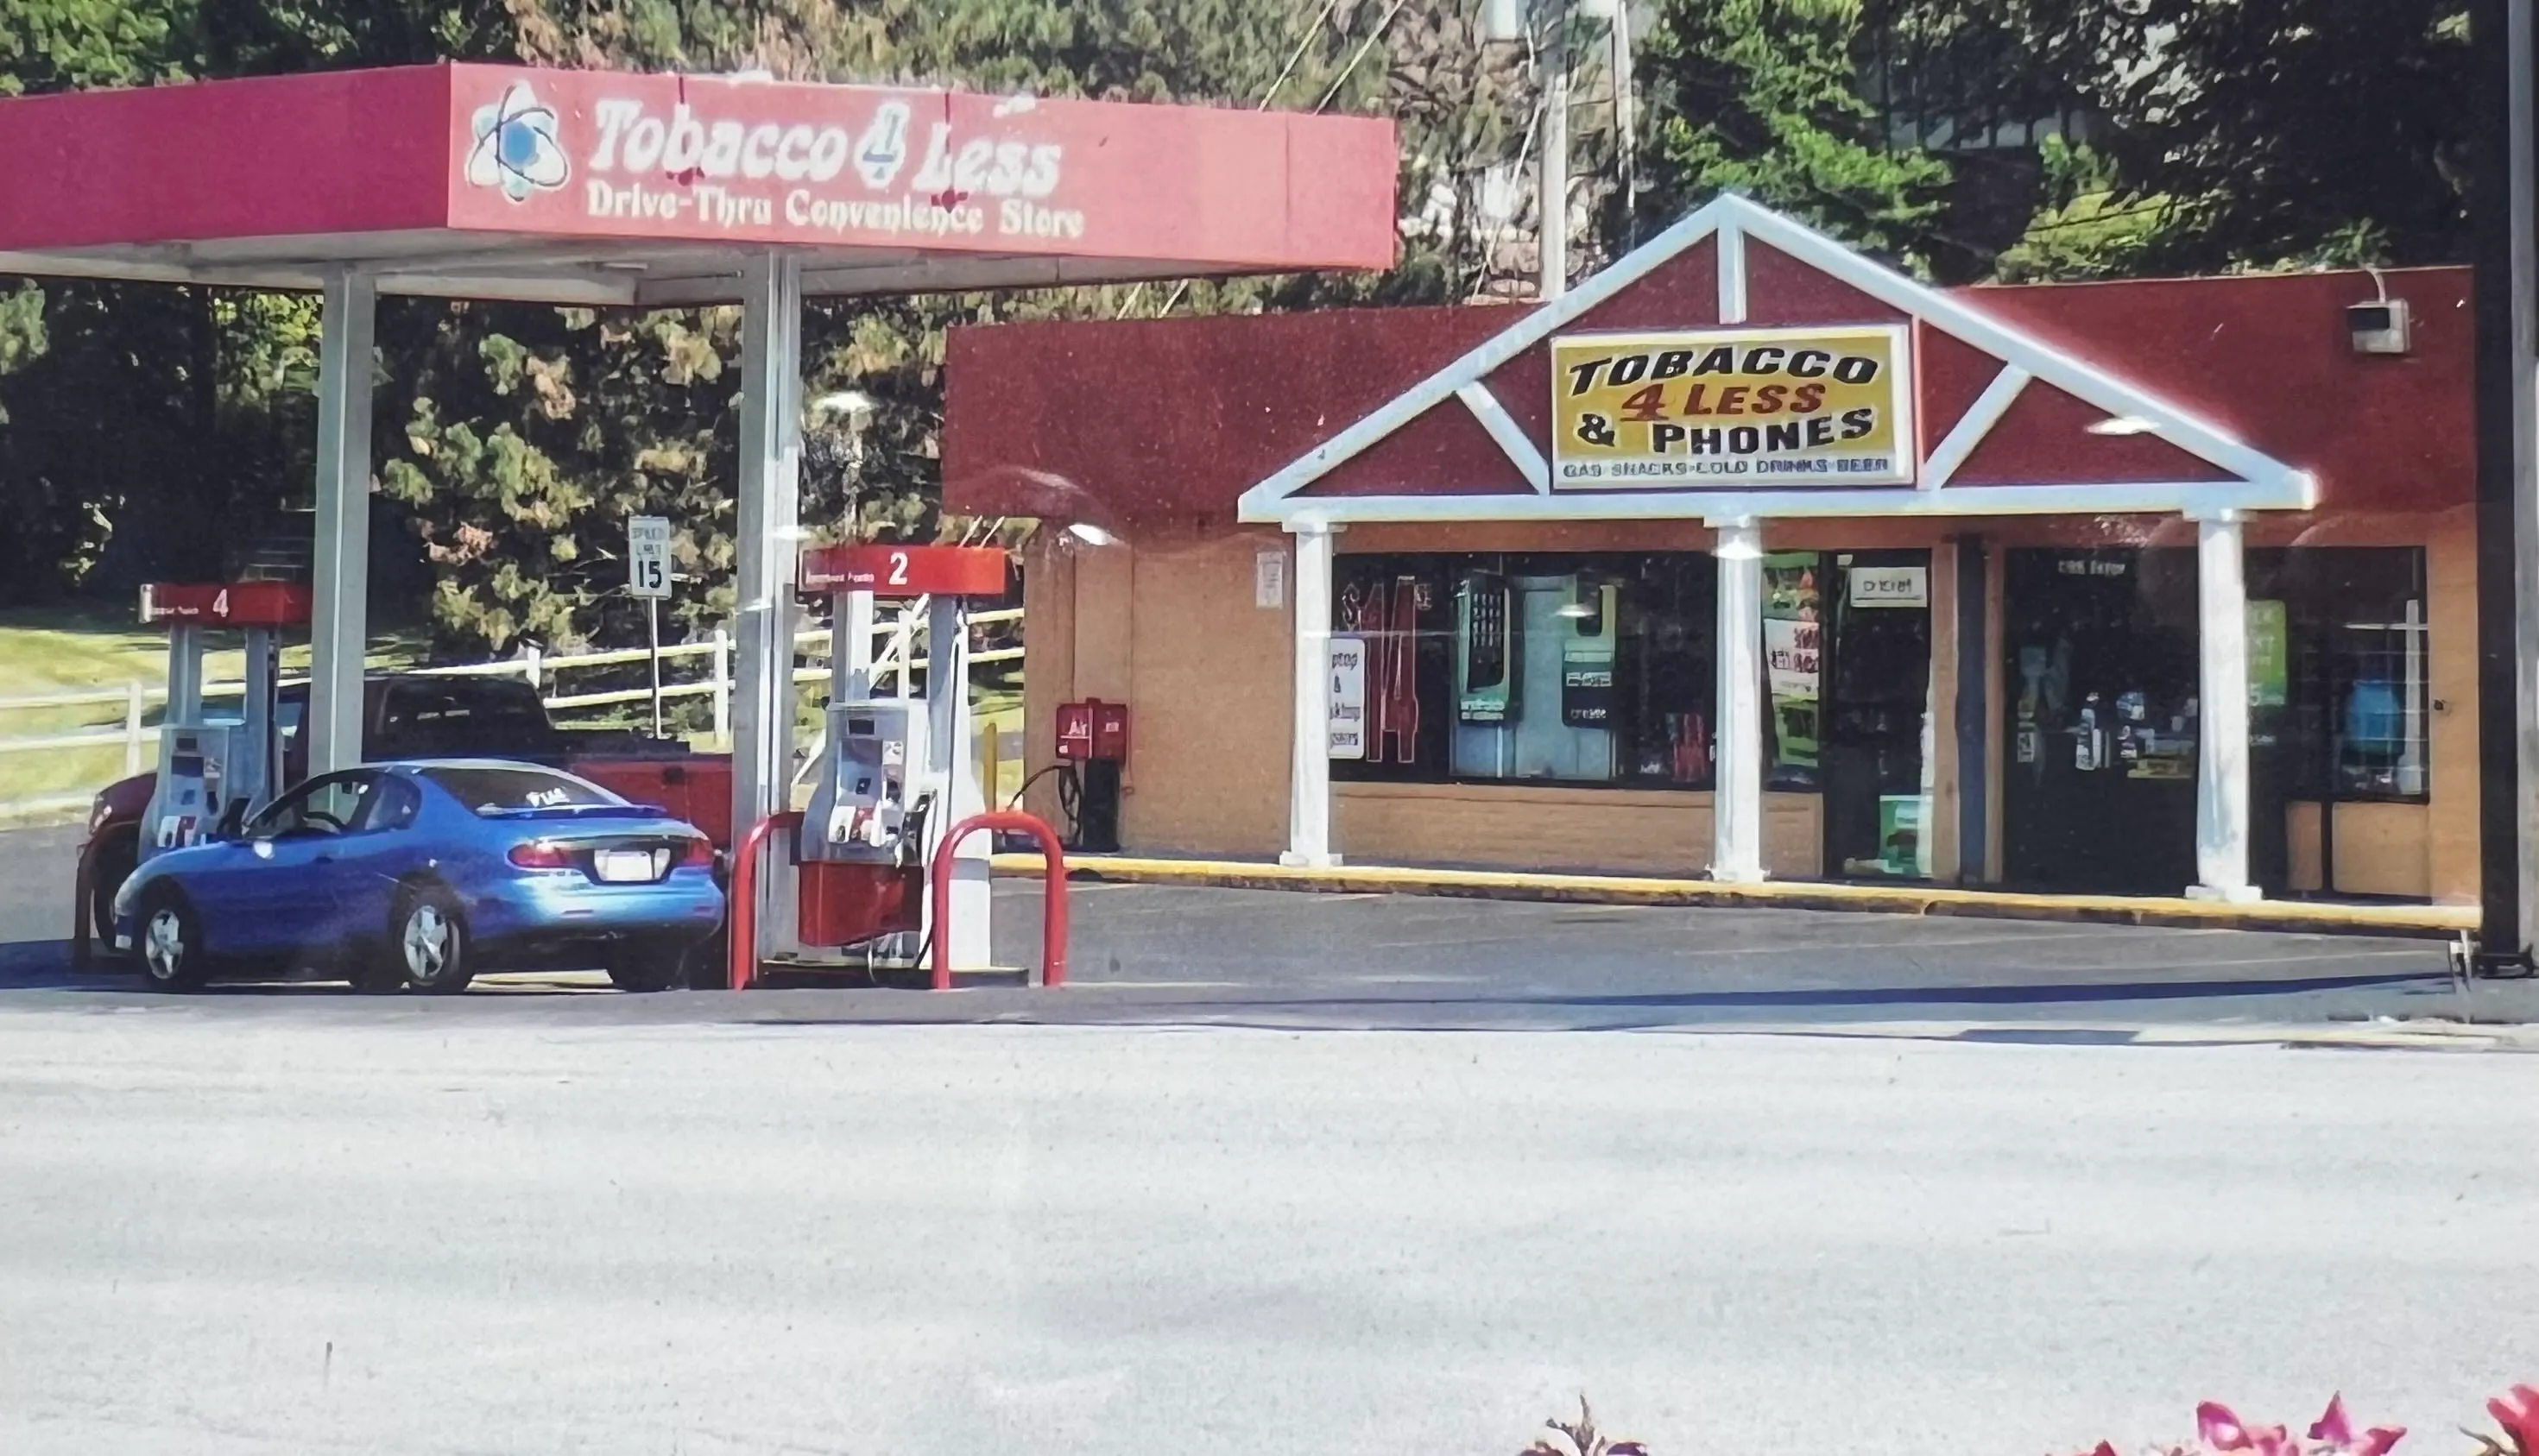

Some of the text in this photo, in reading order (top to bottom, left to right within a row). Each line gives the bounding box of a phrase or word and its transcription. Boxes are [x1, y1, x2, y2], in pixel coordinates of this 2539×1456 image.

[589, 98, 848, 181] Tobacco
[912, 122, 1062, 196] Less
[586, 178, 1085, 238] Drive-Thru Convenience Store
[1569, 346, 1879, 396] TOBACCO
[1620, 382, 1826, 422] 4 LESS
[1577, 407, 1873, 455] & PHONES
[638, 560, 662, 589] 15
[888, 552, 908, 585] 2
[212, 589, 229, 617] 4
